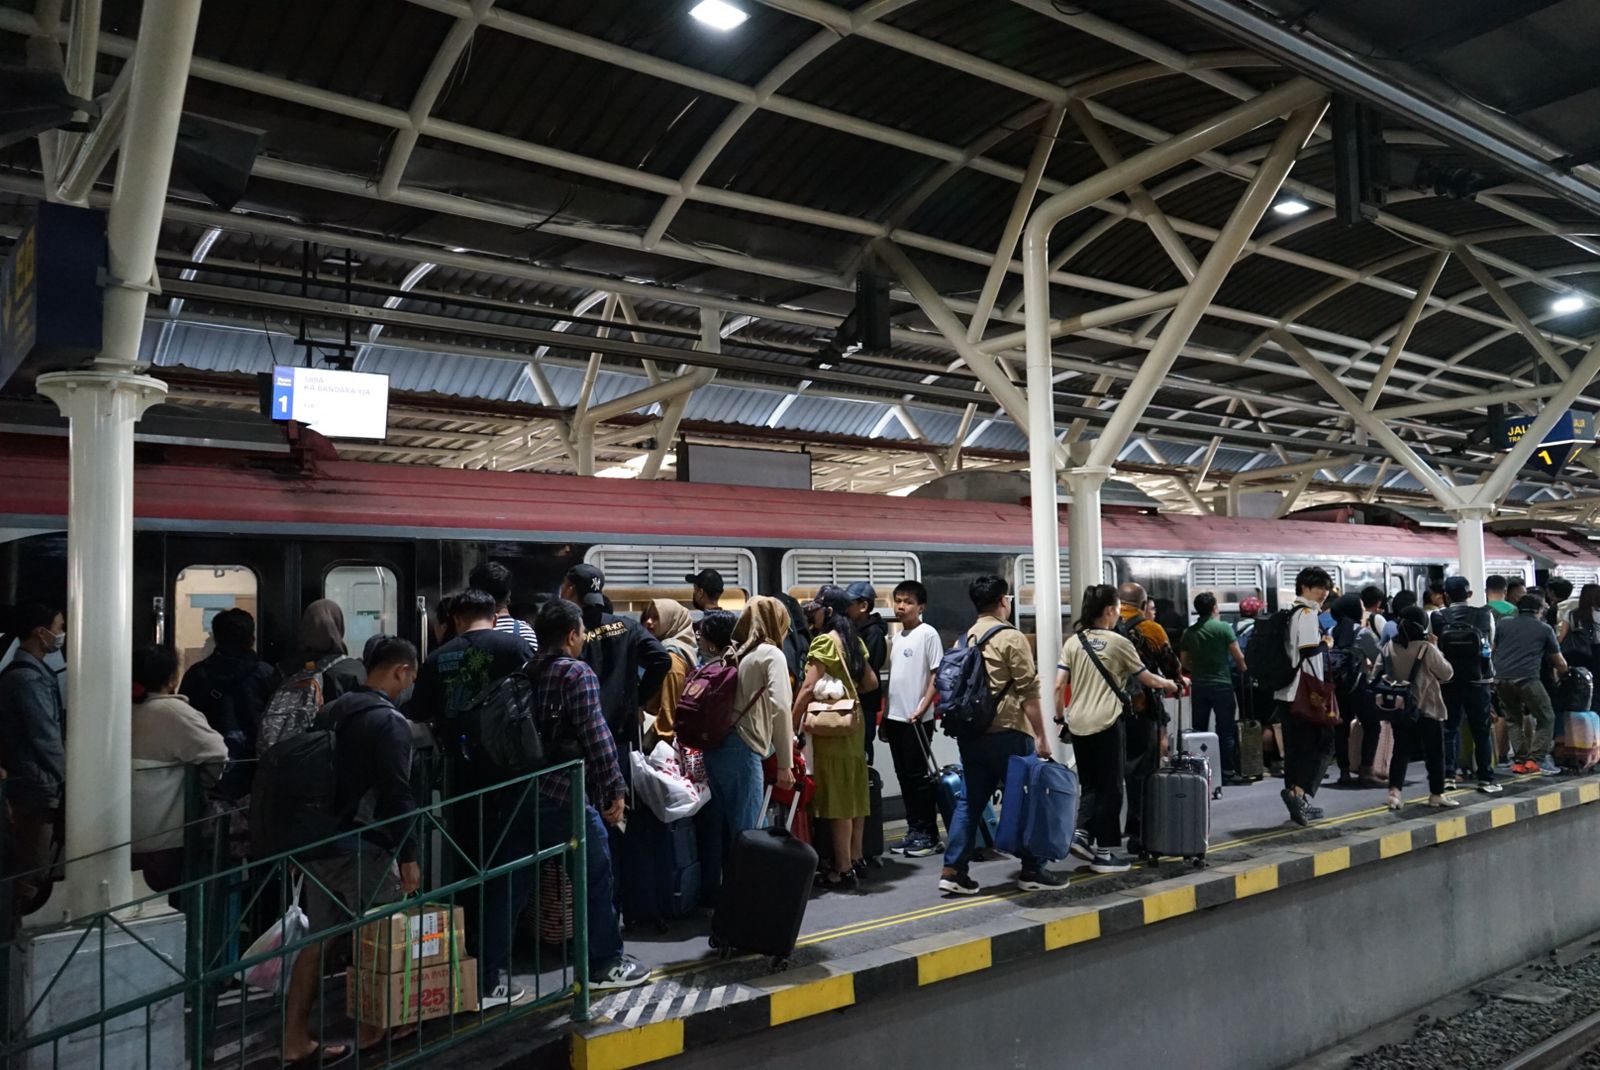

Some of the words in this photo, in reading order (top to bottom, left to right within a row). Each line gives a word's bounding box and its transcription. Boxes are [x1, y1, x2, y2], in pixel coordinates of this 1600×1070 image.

[278, 395, 288, 413] 1
[1507, 424, 1531, 437] JAL
[422, 988, 446, 1007] 25
